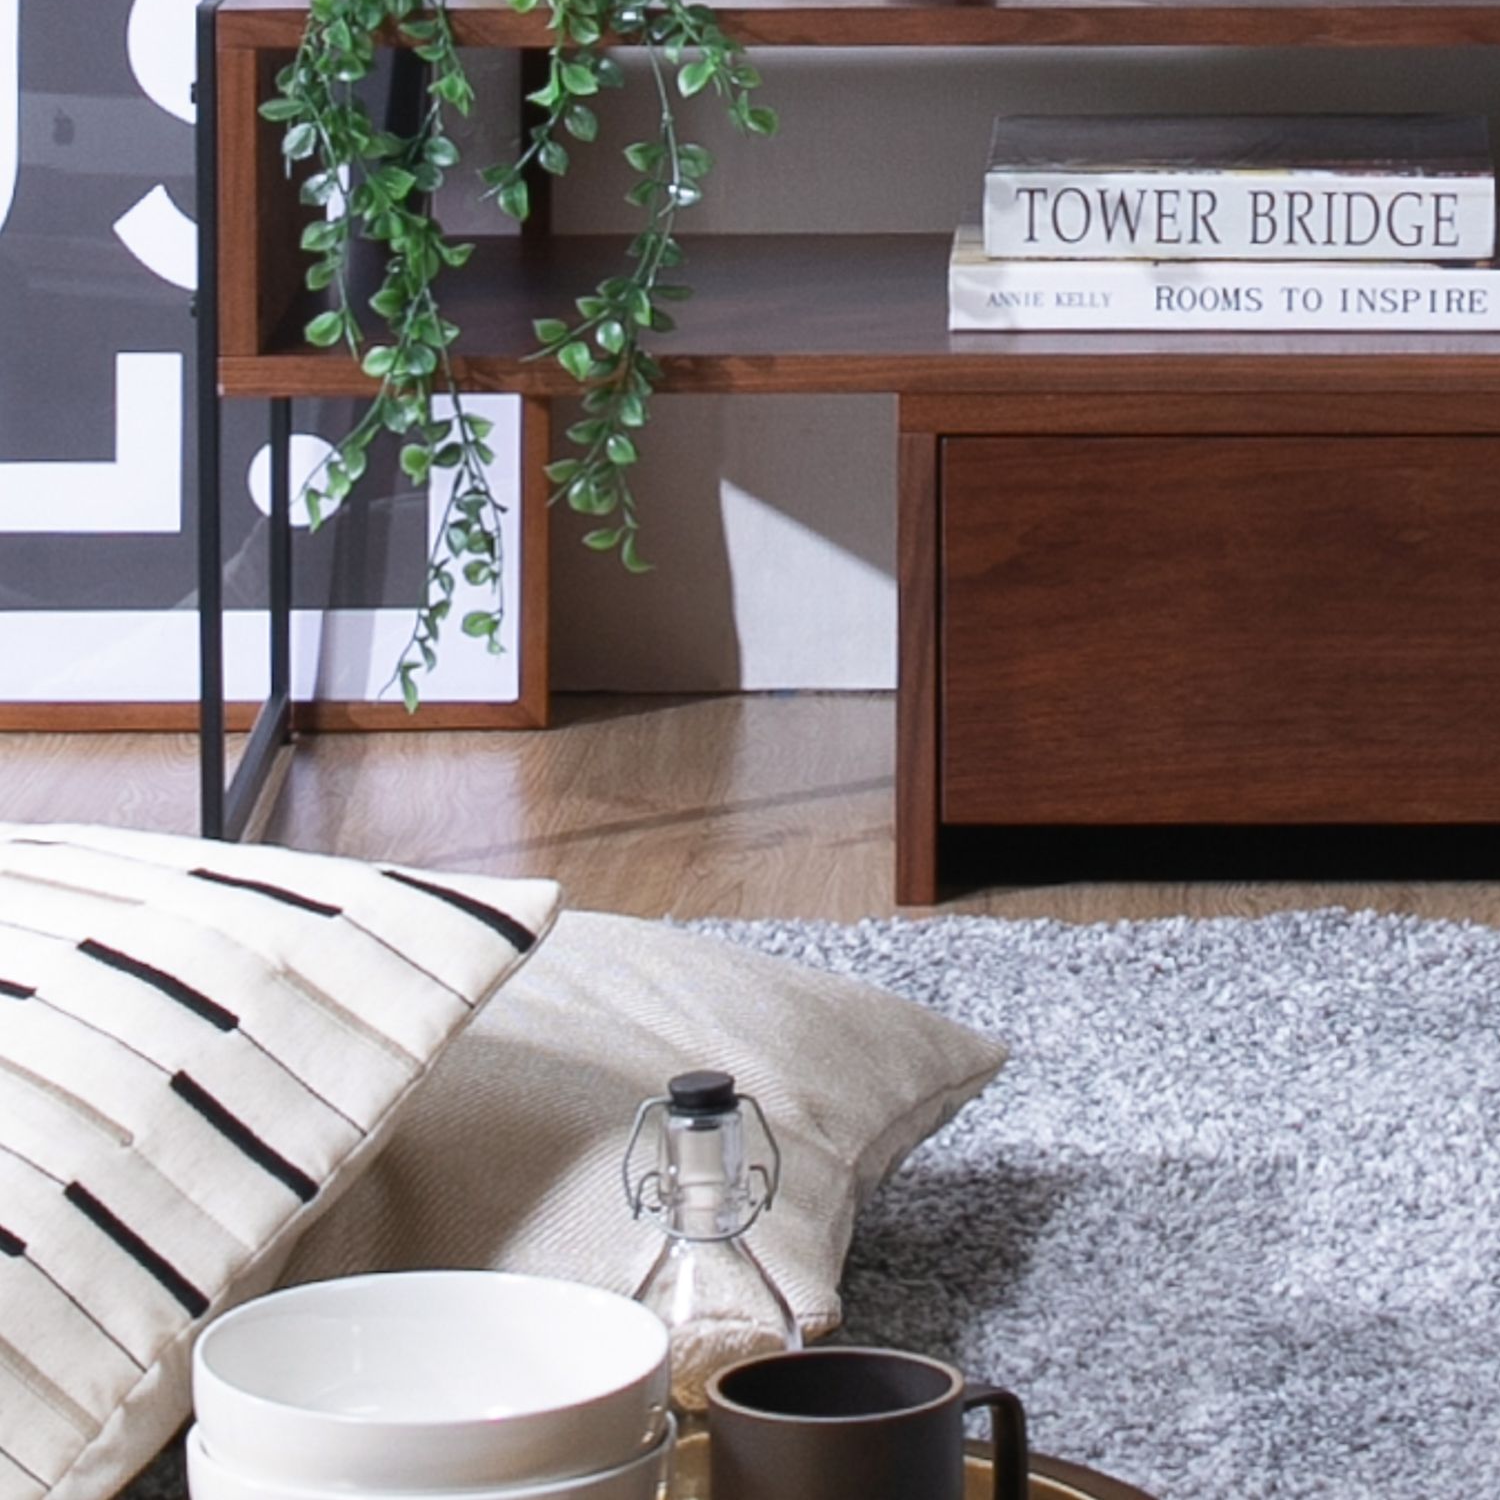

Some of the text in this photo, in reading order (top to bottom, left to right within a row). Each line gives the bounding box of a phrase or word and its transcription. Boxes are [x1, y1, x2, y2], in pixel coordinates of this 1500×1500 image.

[1014, 186, 1460, 248] TOWER BRIDGE
[985, 285, 1488, 314] ANNIE KELLY ROOMS TO INSPIRE
